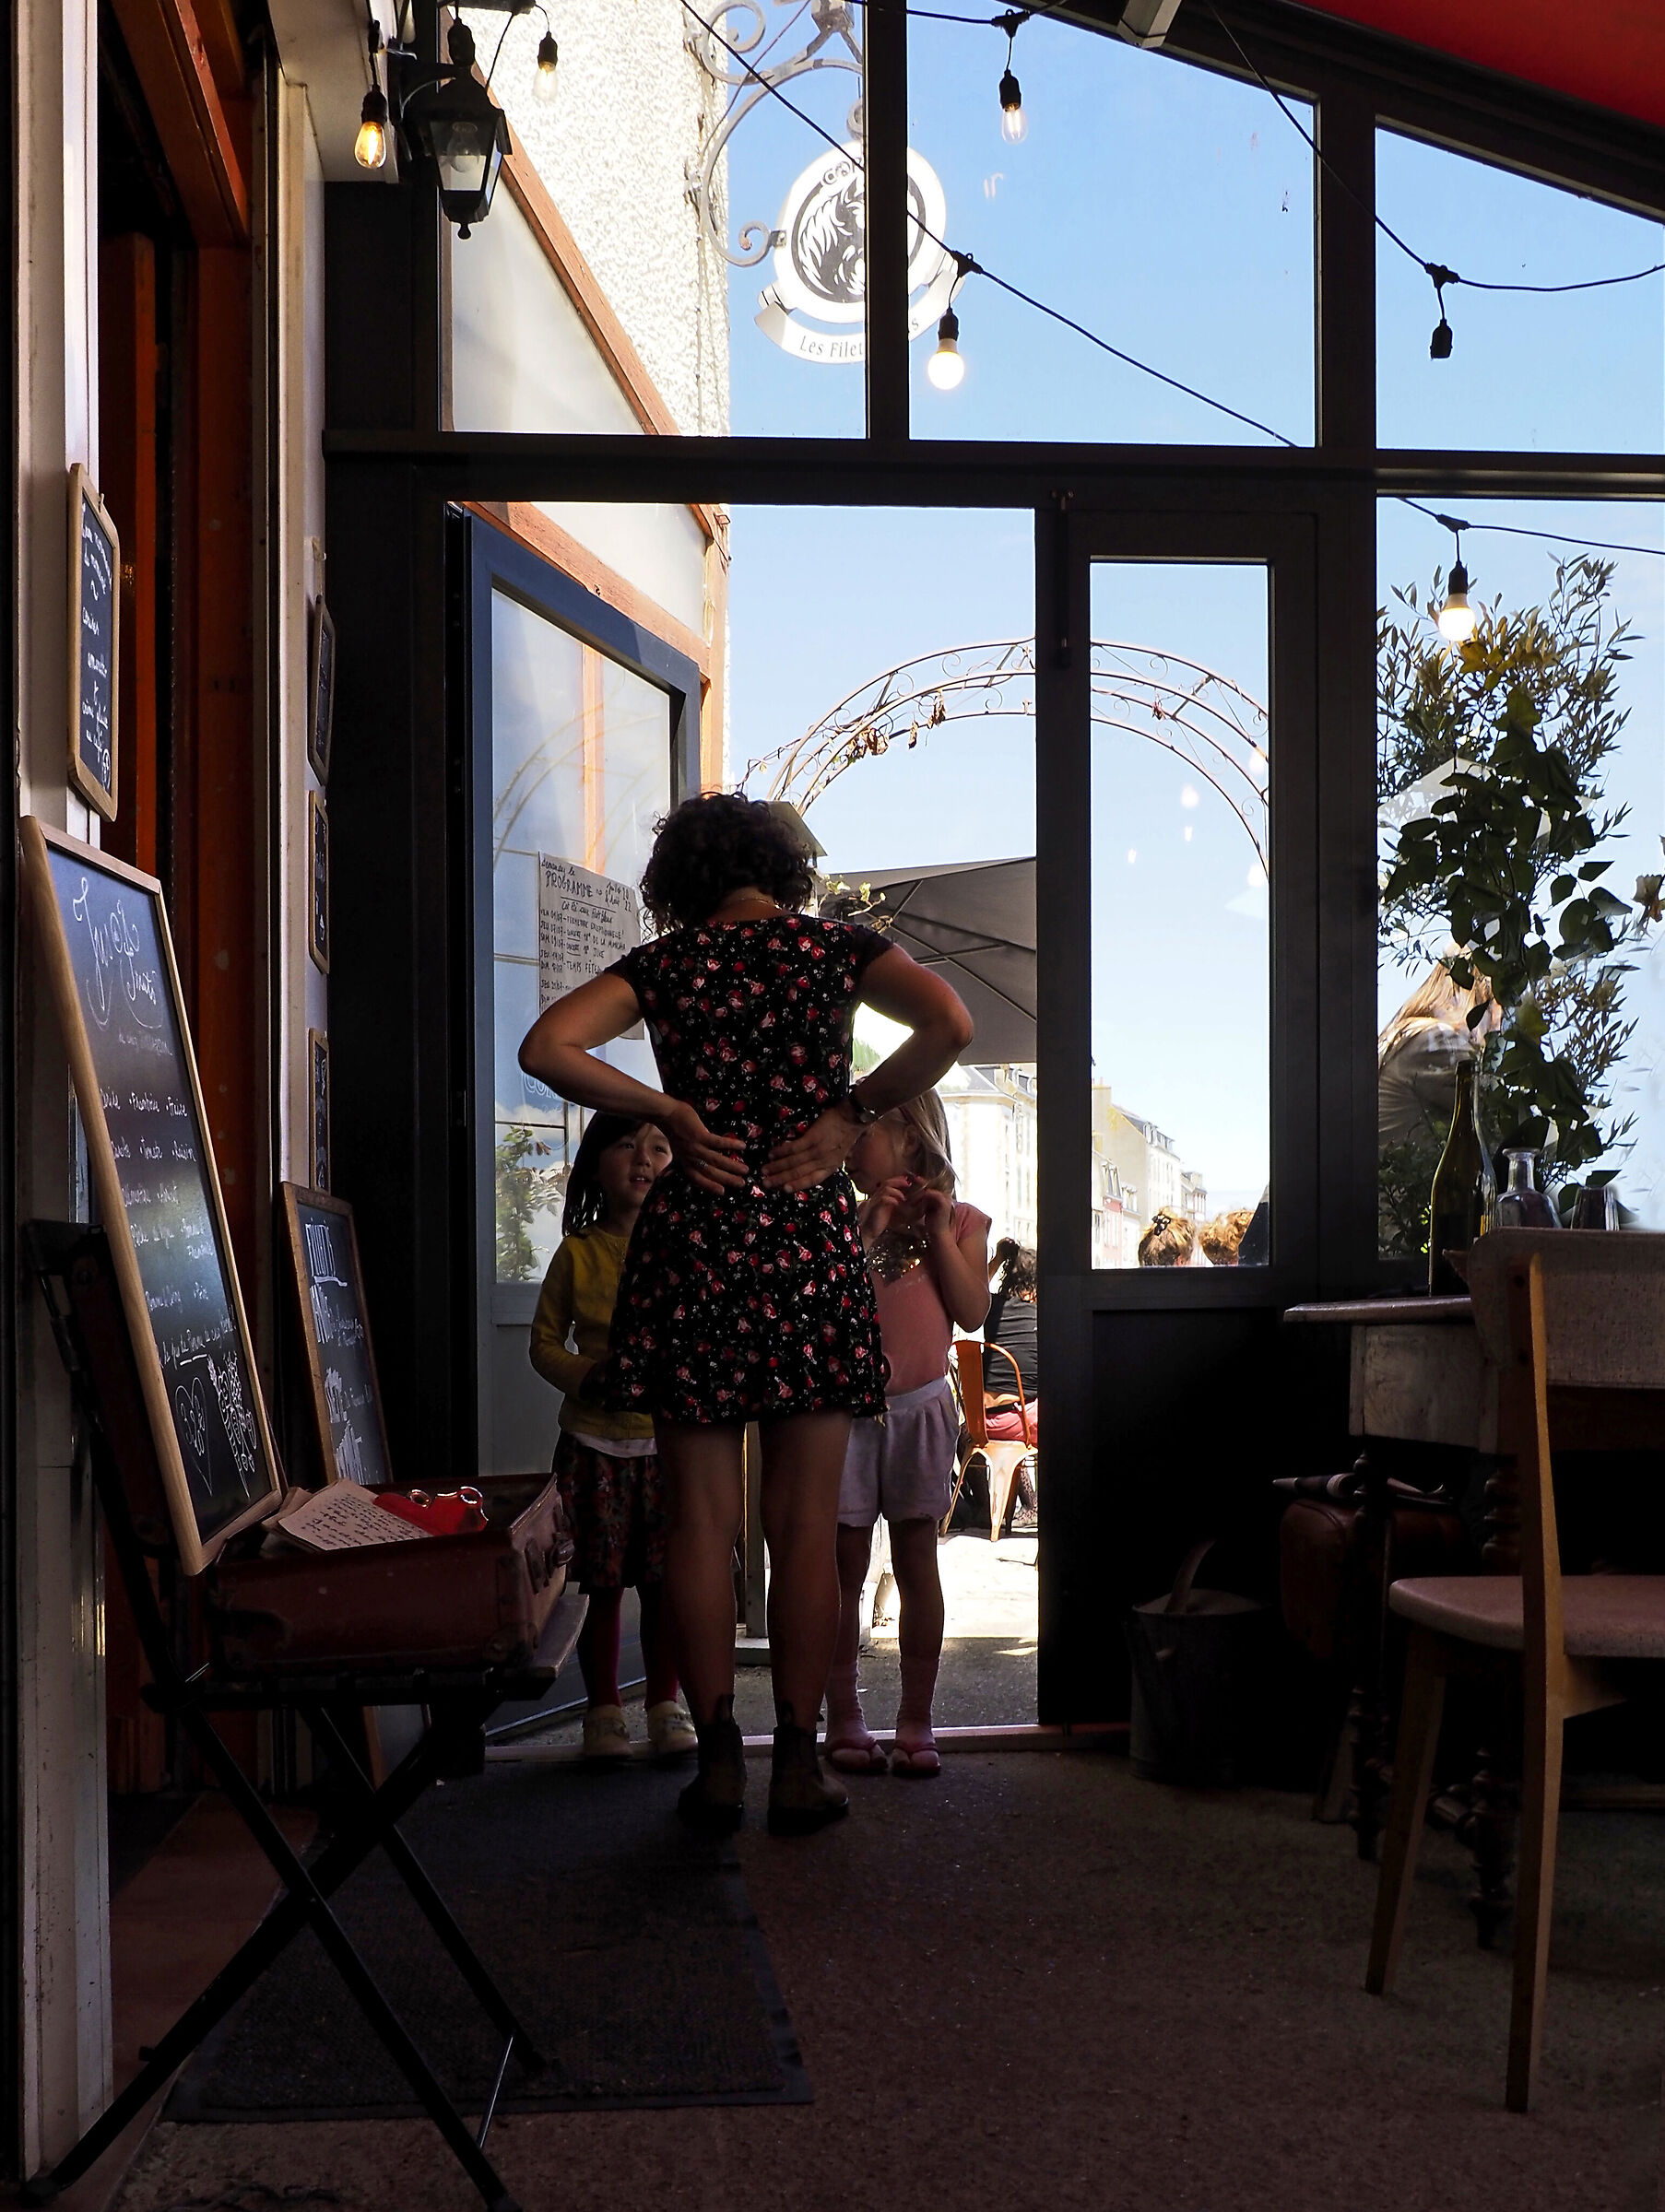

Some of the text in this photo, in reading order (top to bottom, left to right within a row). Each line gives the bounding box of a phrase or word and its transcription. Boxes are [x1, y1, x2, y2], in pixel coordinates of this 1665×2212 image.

[799, 335, 864, 358] Les Filet
[545, 870, 593, 898] PROGRAMME
